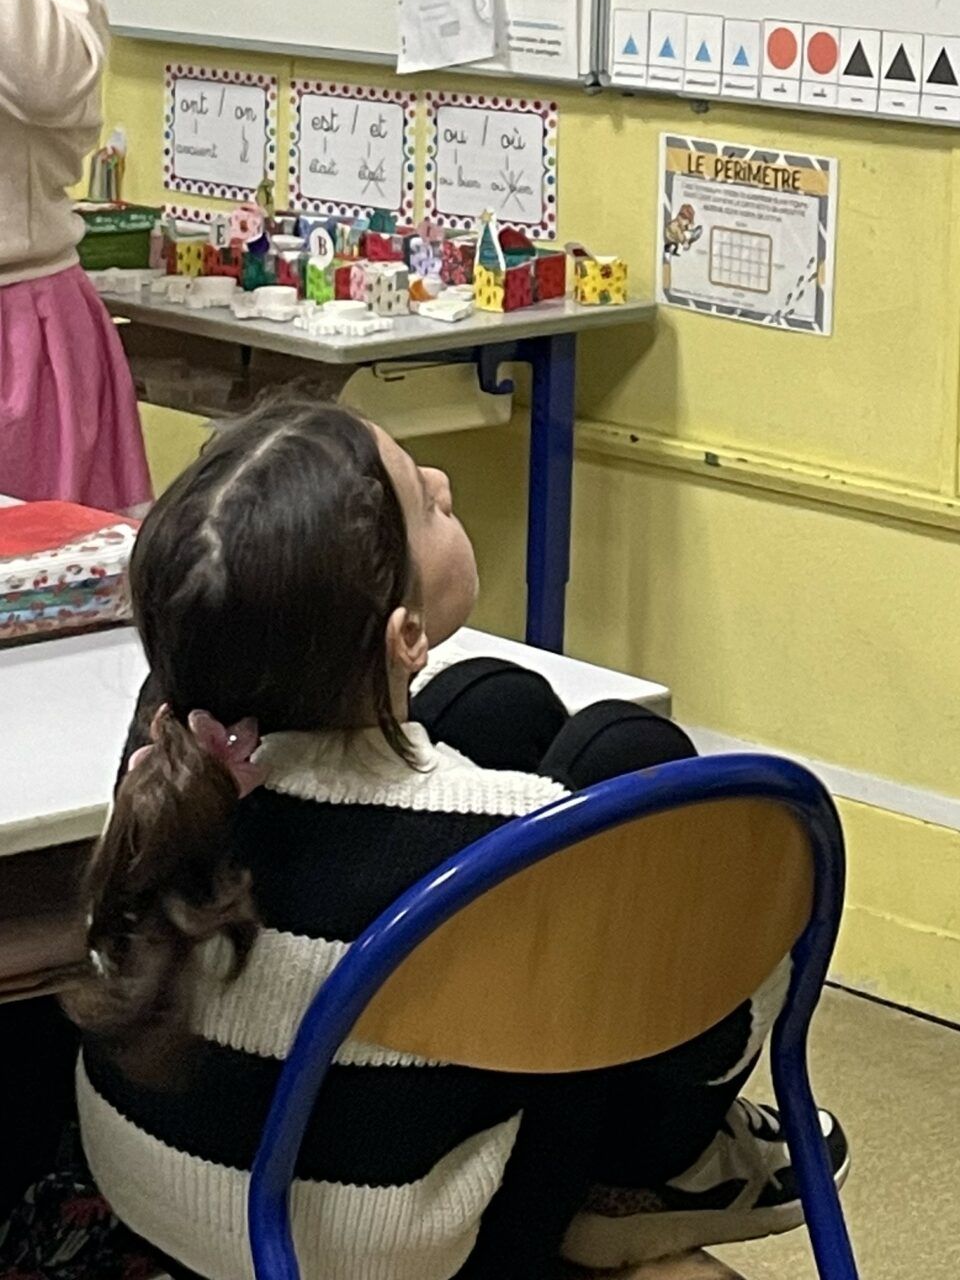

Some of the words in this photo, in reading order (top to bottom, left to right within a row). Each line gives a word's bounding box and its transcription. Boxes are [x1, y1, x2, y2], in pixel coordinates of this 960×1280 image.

[180, 91, 209, 115] ont
[234, 106, 257, 122] on
[311, 107, 341, 133] est
[370, 114, 389, 139] et
[443, 128, 468, 145] ou
[500, 126, 527, 151] où
[687, 152, 706, 175] LE
[317, 234, 329, 257] B
